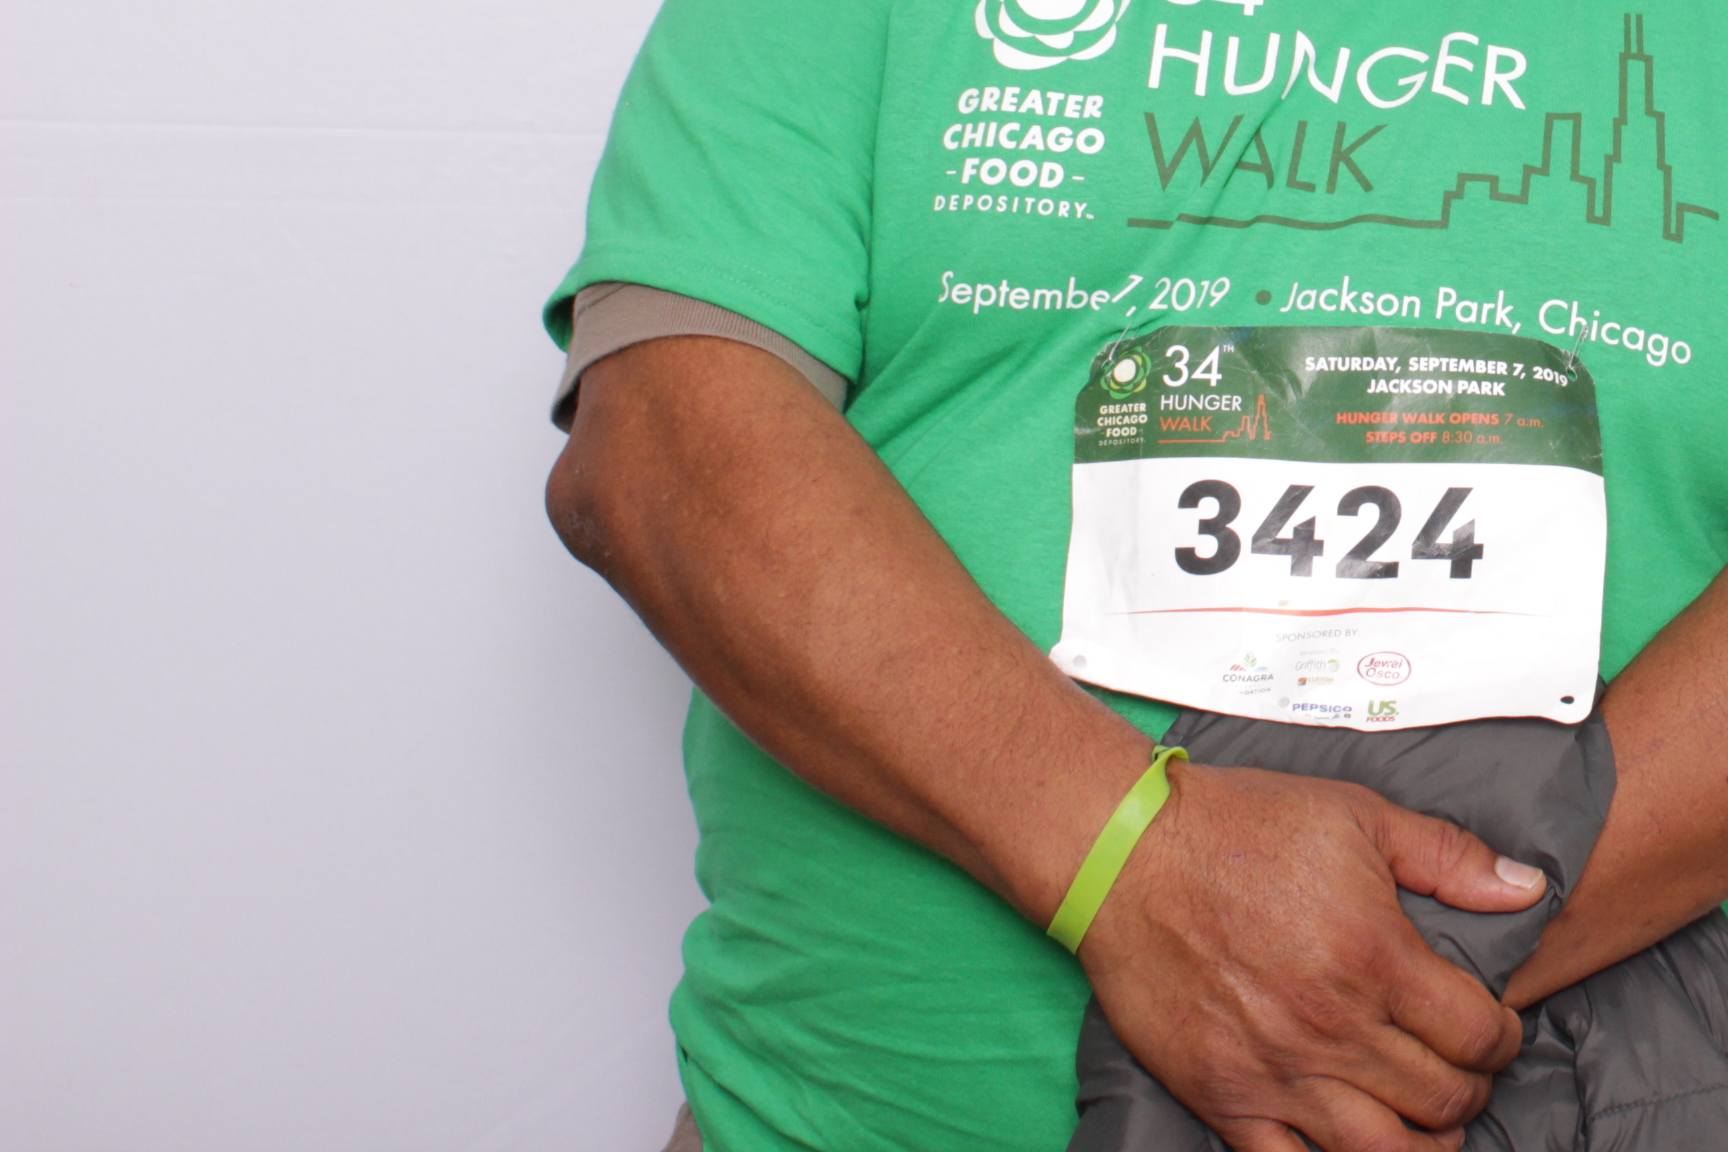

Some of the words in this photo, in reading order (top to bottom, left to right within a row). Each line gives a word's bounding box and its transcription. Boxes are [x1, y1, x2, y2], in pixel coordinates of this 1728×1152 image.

[1148, 24, 1527, 110] HUNGER
[958, 86, 1104, 119] GREATER
[943, 121, 1106, 155] CHICAGO
[1143, 111, 1389, 194] WALK
[938, 270, 1111, 315] Septembe
[1111, 274, 1144, 317] 7,
[1149, 276, 1231, 311] 2019
[1279, 275, 1422, 318] Jackson
[1435, 286, 1522, 335] Park,
[1538, 299, 1692, 367] Chicago
[1304, 356, 1402, 374] SATURDAY,
[1408, 357, 1508, 376] SEPTEMBER
[1512, 363, 1526, 380] 7,
[1532, 366, 1569, 387] 2019
[1366, 379, 1453, 395] JACKSON
[1457, 380, 1506, 396] PARK
[1099, 402, 1147, 415] GREATER
[1160, 394, 1242, 411] HUNGER
[1097, 414, 1148, 427] CHICAGO
[1159, 416, 1213, 432] WALK
[1335, 412, 1398, 425] HUNGER
[1402, 412, 1446, 425] WALK
[1449, 413, 1500, 426] OPENS
[1503, 413, 1515, 426] 7
[1516, 417, 1544, 428] a.m.
[1365, 431, 1407, 444] STEPS
[1410, 431, 1438, 444] OFF
[1442, 431, 1473, 444] 8:30
[1476, 434, 1504, 445] a.m.
[1174, 479, 1485, 581] 3424
[1275, 629, 1342, 643] SPONSORED
[1295, 659, 1327, 671] Griffith
[1364, 657, 1403, 669] Jewel
[1222, 673, 1275, 683] CONAGRA
[1292, 703, 1353, 713] PEPSICO
[1366, 715, 1396, 723] FOODS
